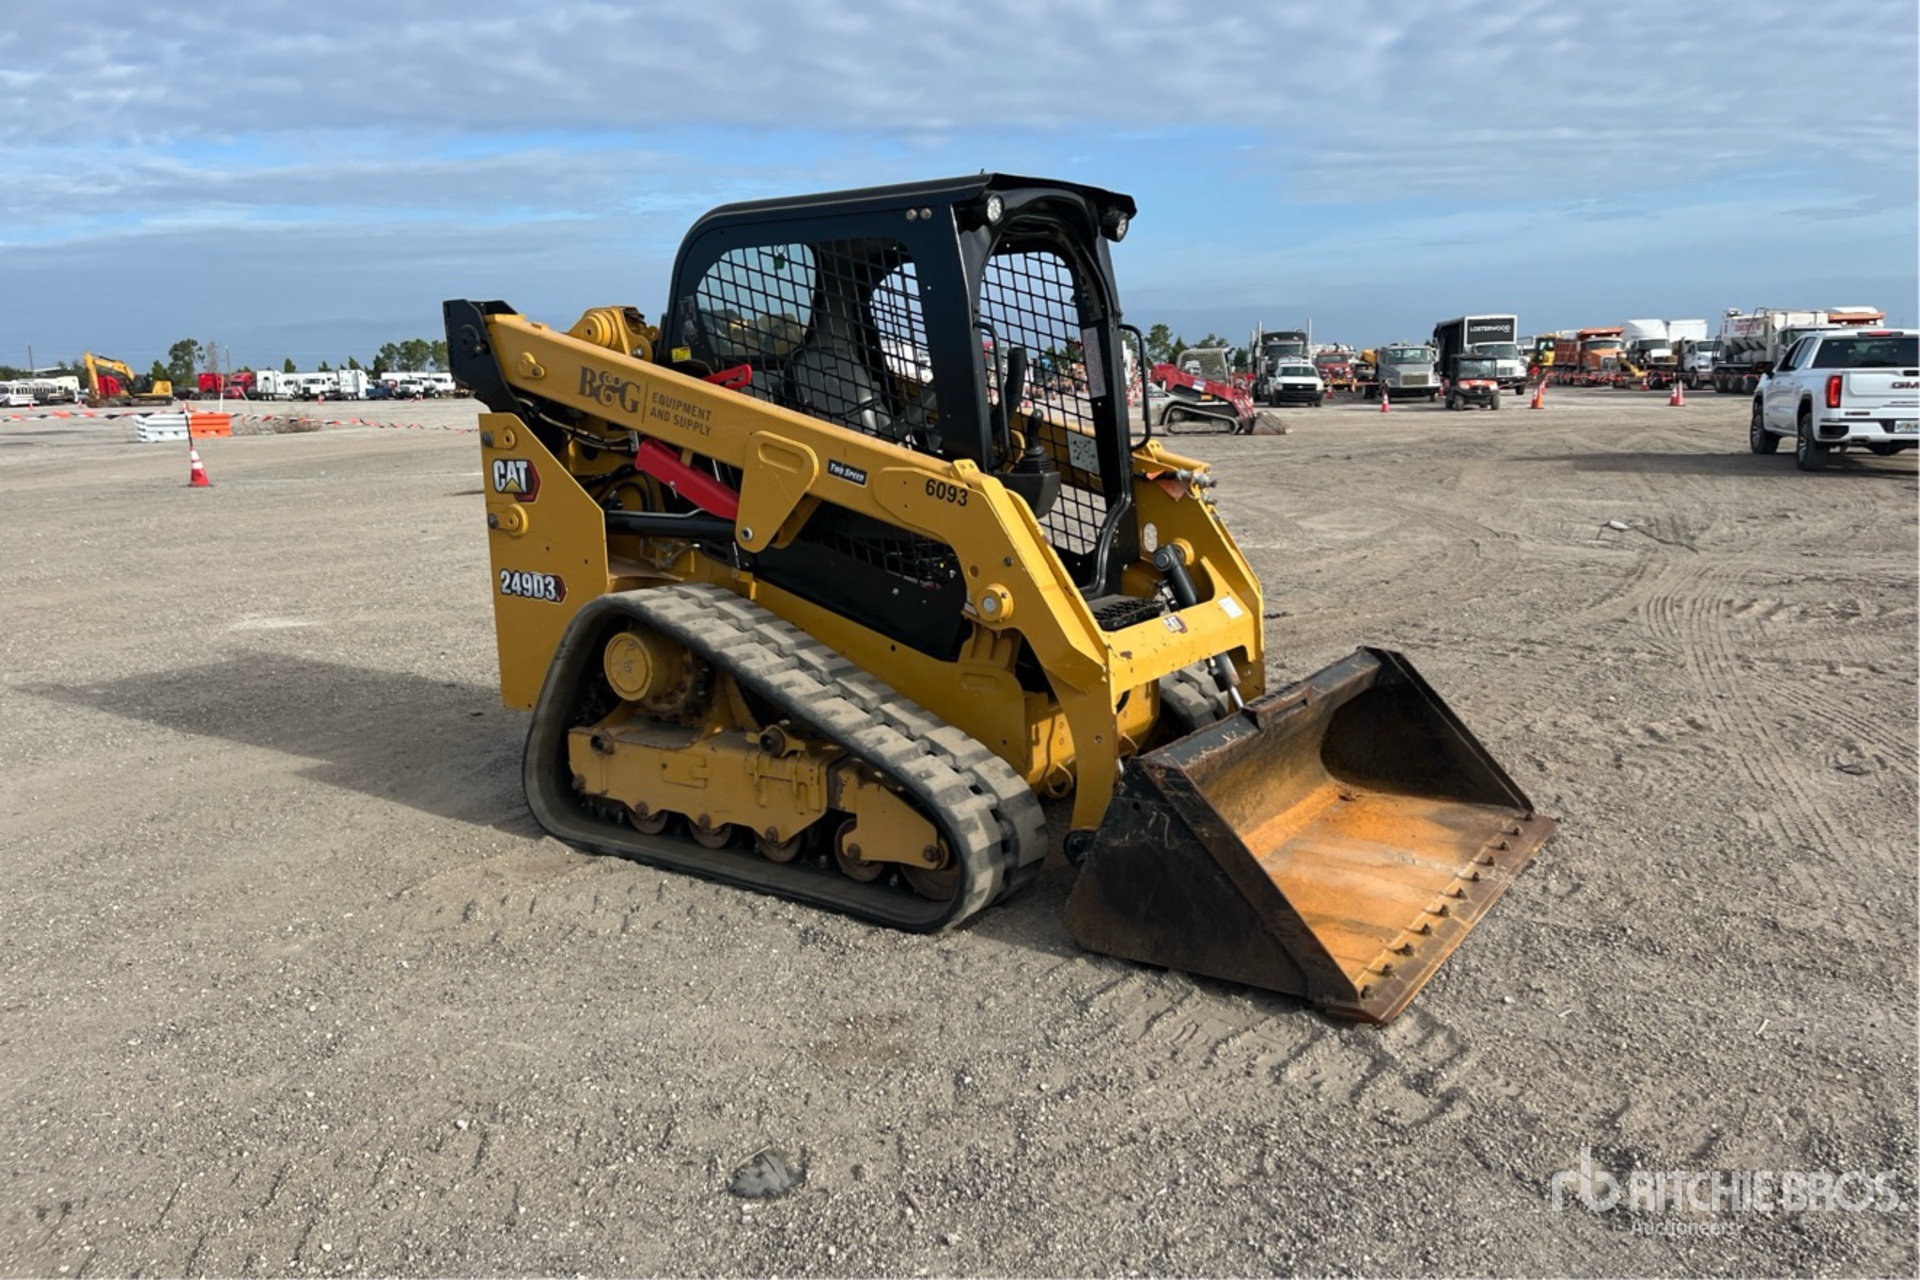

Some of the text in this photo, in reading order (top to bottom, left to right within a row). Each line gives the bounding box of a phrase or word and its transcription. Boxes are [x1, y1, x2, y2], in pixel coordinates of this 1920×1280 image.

[577, 365, 640, 413] B&G
[652, 391, 712, 421] EQUIPMENT
[650, 407, 712, 437] AND SUPPLY
[493, 460, 528, 493] CAT
[925, 478, 968, 507] 6093
[500, 569, 556, 601] 249D3
